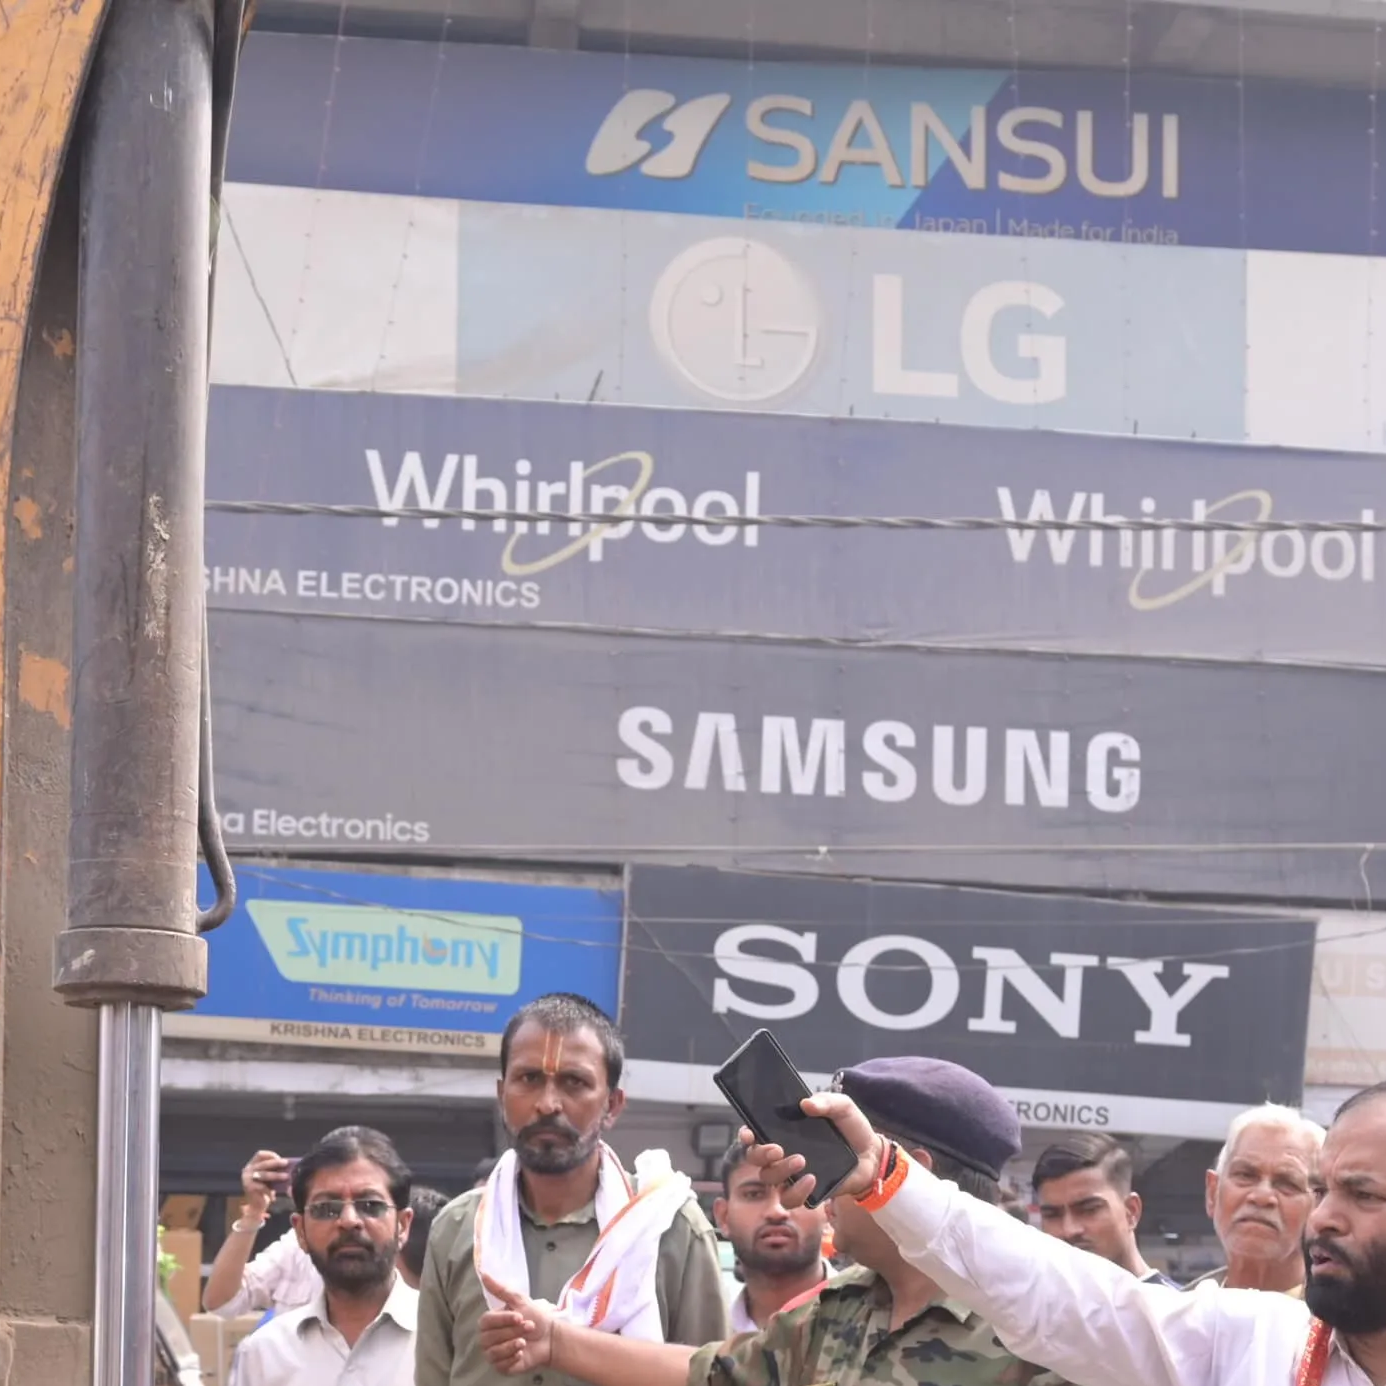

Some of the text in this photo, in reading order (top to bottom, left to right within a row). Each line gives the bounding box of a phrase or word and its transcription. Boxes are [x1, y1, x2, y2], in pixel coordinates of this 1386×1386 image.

[745, 94, 1179, 198] SANSUI
[915, 211, 988, 234] Japan
[1008, 218, 1075, 240] Made
[1082, 219, 1116, 242] for
[1122, 218, 1179, 246] India
[872, 273, 1068, 405] LG
[365, 449, 761, 562] Whirlpool
[997, 486, 1375, 597] Whirlpool
[297, 569, 542, 609] ELECTRONICS
[615, 705, 1142, 813] SAMSUNG
[251, 808, 431, 844] Electronics
[285, 916, 500, 981] Symphony
[712, 923, 1230, 1048] SONY
[269, 1022, 487, 1050] KRISHNA ELECTRONICS
[308, 987, 382, 1010] Thinking
[386, 992, 407, 1009] of
